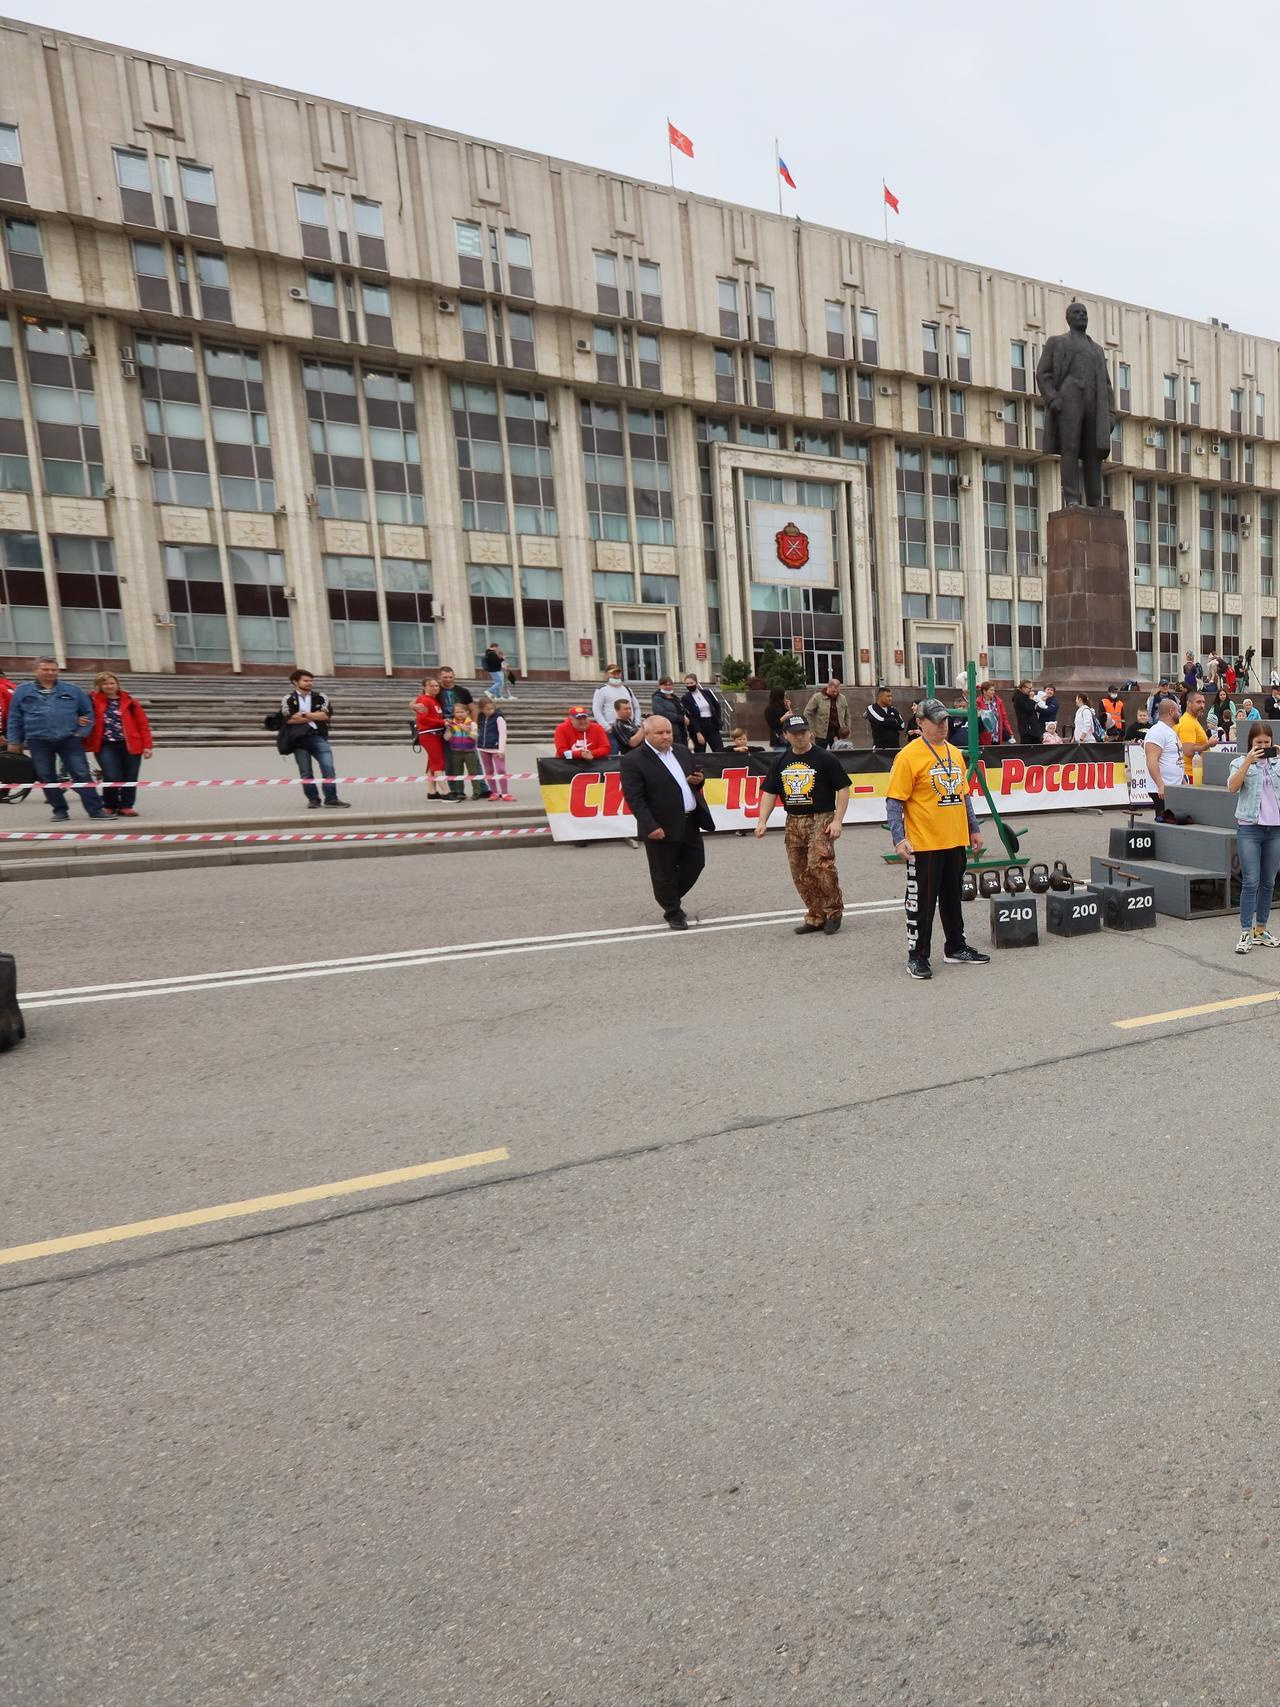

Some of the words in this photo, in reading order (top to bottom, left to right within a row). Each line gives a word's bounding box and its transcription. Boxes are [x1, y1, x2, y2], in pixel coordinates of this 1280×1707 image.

[1000, 758, 1115, 795] России
[1128, 837, 1152, 849] 180
[1013, 876, 1024, 884] 32
[1127, 895, 1153, 910] 220
[999, 907, 1033, 923] 240
[1072, 903, 1098, 919] 200
